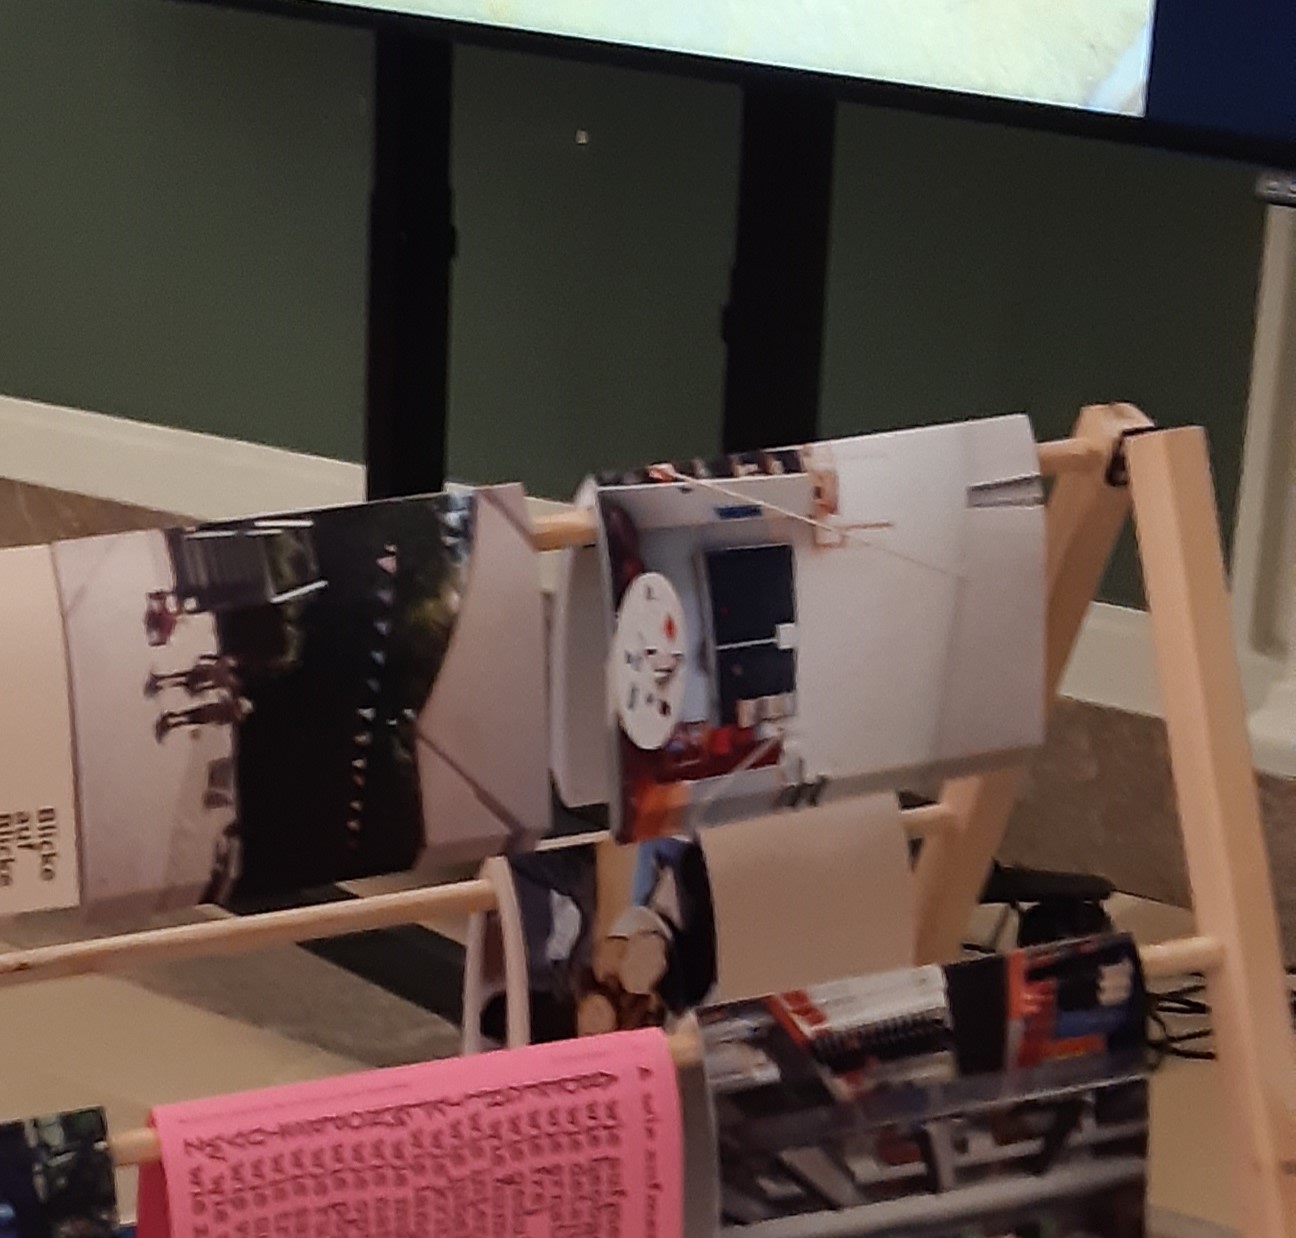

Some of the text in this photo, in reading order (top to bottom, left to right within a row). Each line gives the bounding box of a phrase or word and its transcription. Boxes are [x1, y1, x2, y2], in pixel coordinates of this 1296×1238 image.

[15, 811, 42, 850] auf
[38, 807, 57, 881] Blicke
[467, 1112, 485, 1160] wie
[509, 1114, 525, 1161] wie
[529, 1110, 546, 1158] wie
[548, 1107, 565, 1153] wie
[567, 1106, 583, 1153] wie
[586, 1102, 602, 1151] wie
[605, 1099, 621, 1147] wie
[642, 1094, 658, 1139] wie
[371, 1139, 389, 1188] wie
[391, 1140, 410, 1187] wie
[409, 1129, 428, 1176] wie
[430, 1129, 447, 1177] wie
[448, 1118, 467, 1166] wie
[490, 1119, 508, 1167] wie
[190, 1165, 208, 1216] wie
[231, 1161, 251, 1211] wie
[250, 1158, 271, 1208] wie
[272, 1153, 291, 1202] wie
[292, 1151, 311, 1197] wie
[311, 1147, 330, 1196] wie
[330, 1145, 348, 1192] wie
[352, 1142, 369, 1192] wie
[210, 1173, 230, 1225] wie
